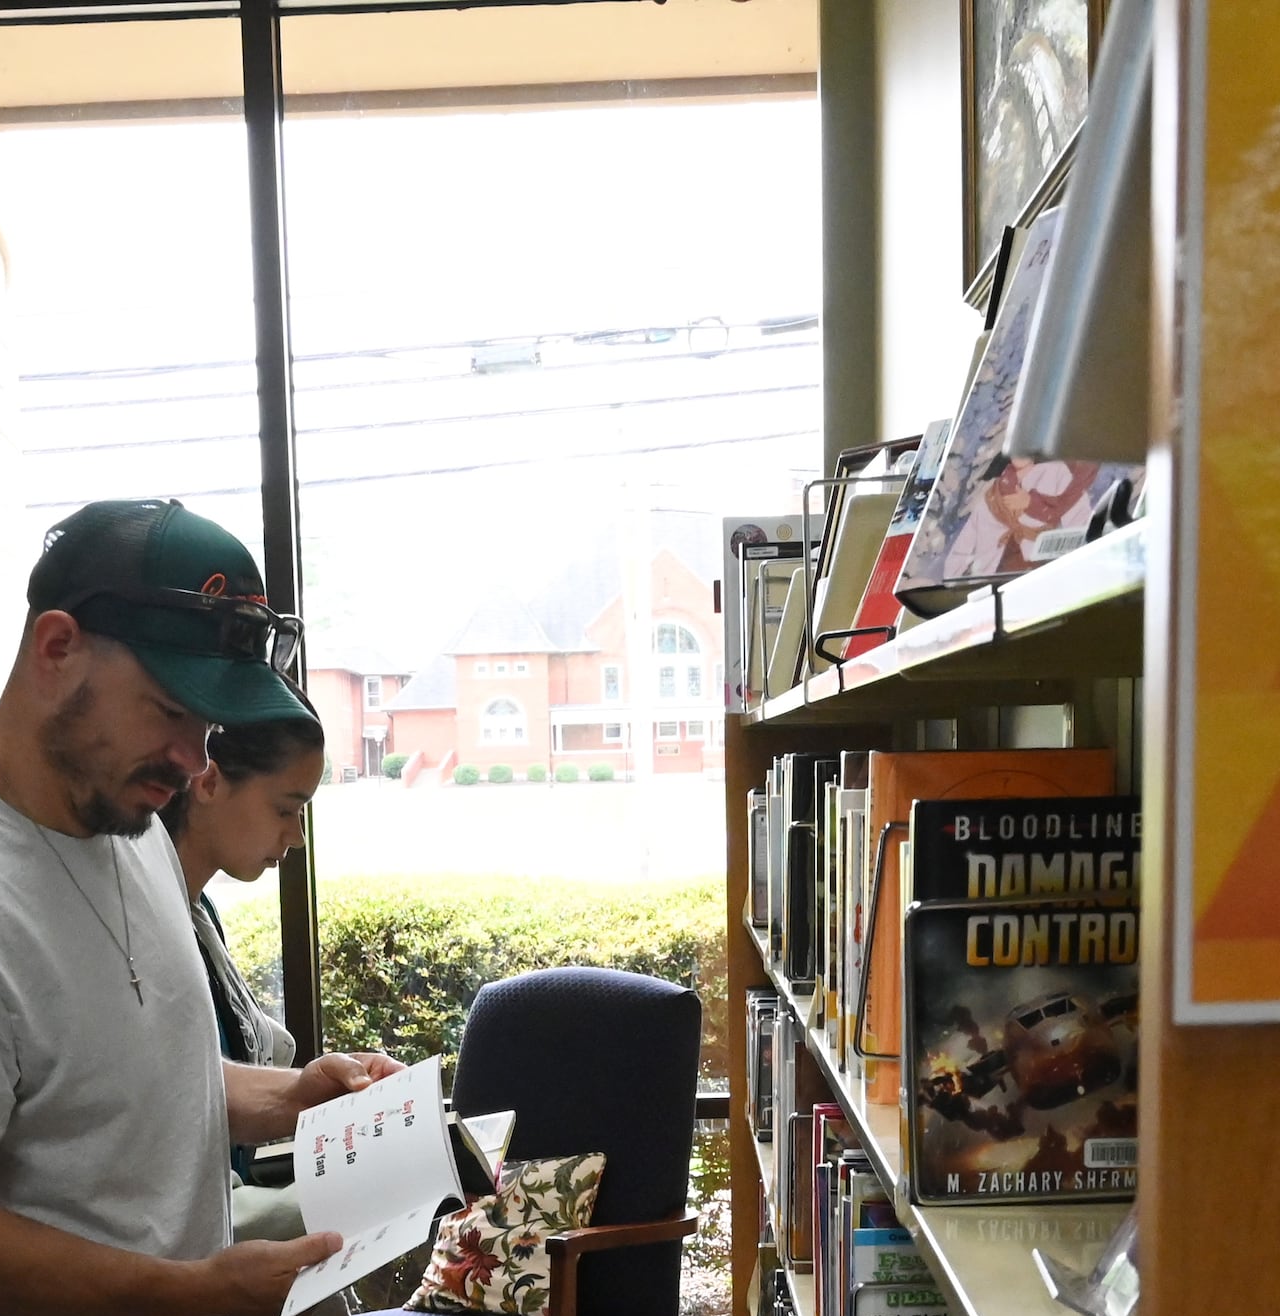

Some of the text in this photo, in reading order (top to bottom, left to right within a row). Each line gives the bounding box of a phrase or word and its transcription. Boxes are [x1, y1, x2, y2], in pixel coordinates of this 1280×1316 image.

[314, 1154, 327, 1177] Yang
[947, 1173, 967, 1193] M.
[977, 1170, 1064, 1193] ZACHARY
